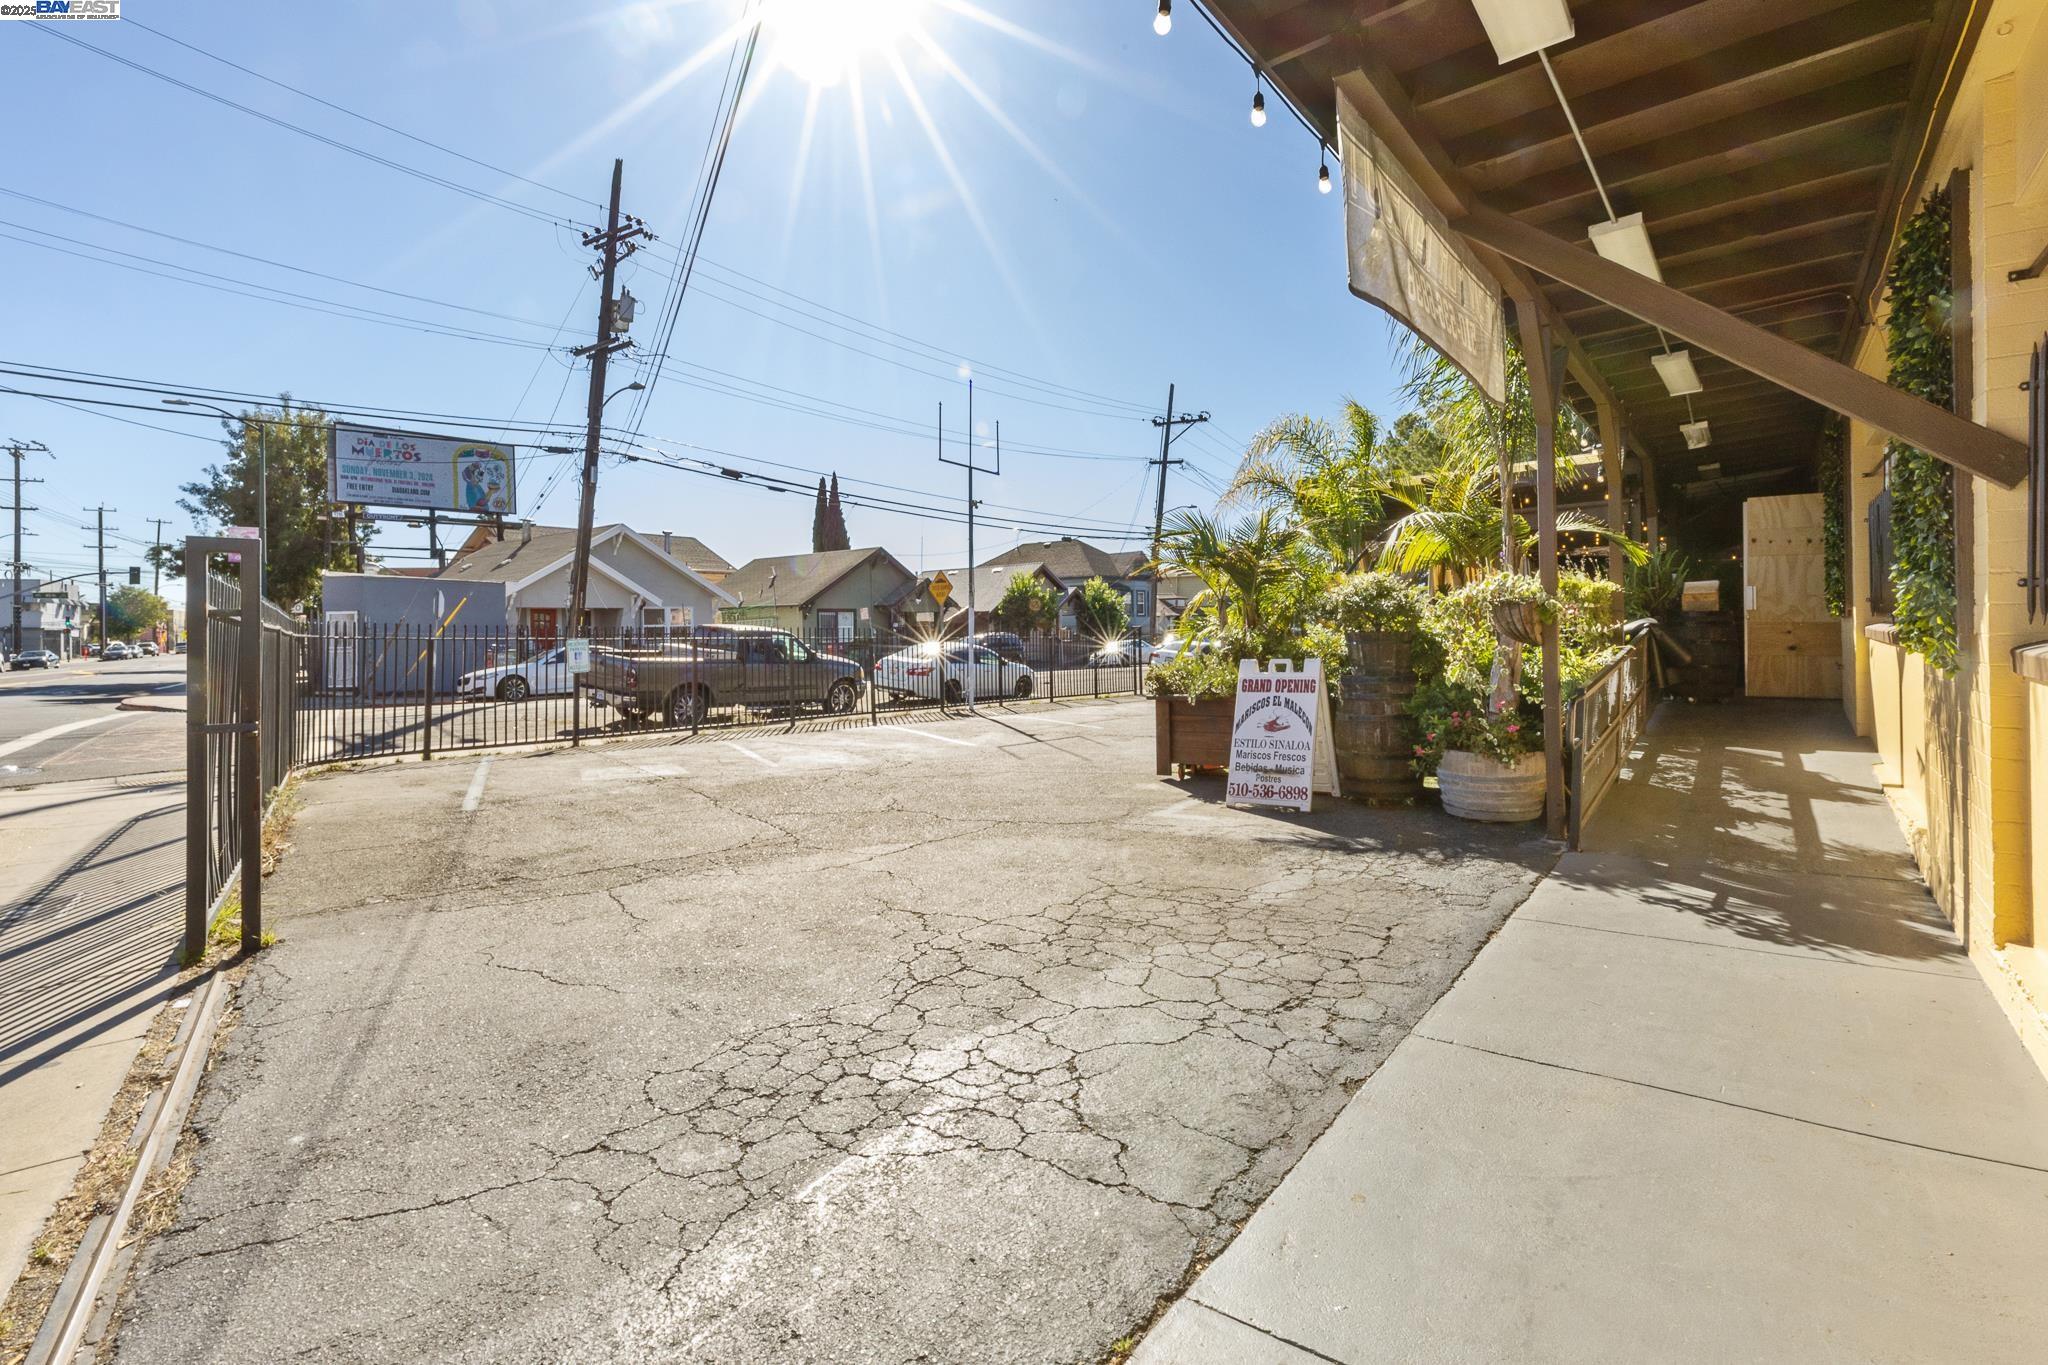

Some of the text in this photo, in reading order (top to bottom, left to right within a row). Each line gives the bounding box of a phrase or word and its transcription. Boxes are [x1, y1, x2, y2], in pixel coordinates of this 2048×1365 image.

[352, 446, 421, 461] MUERTOS
[1241, 678, 1317, 694] GRAND OPENING
[1235, 695, 1313, 737] MARISCOS EL MALECON
[1233, 738, 1311, 751] ESTILO SINALOA
[1235, 749, 1306, 762] Mariscos Frescos
[1235, 762, 1268, 774] Bebidas
[1275, 764, 1305, 776] Musica
[1255, 773, 1282, 784] Postres
[1228, 782, 1309, 801] 510-536-6898
